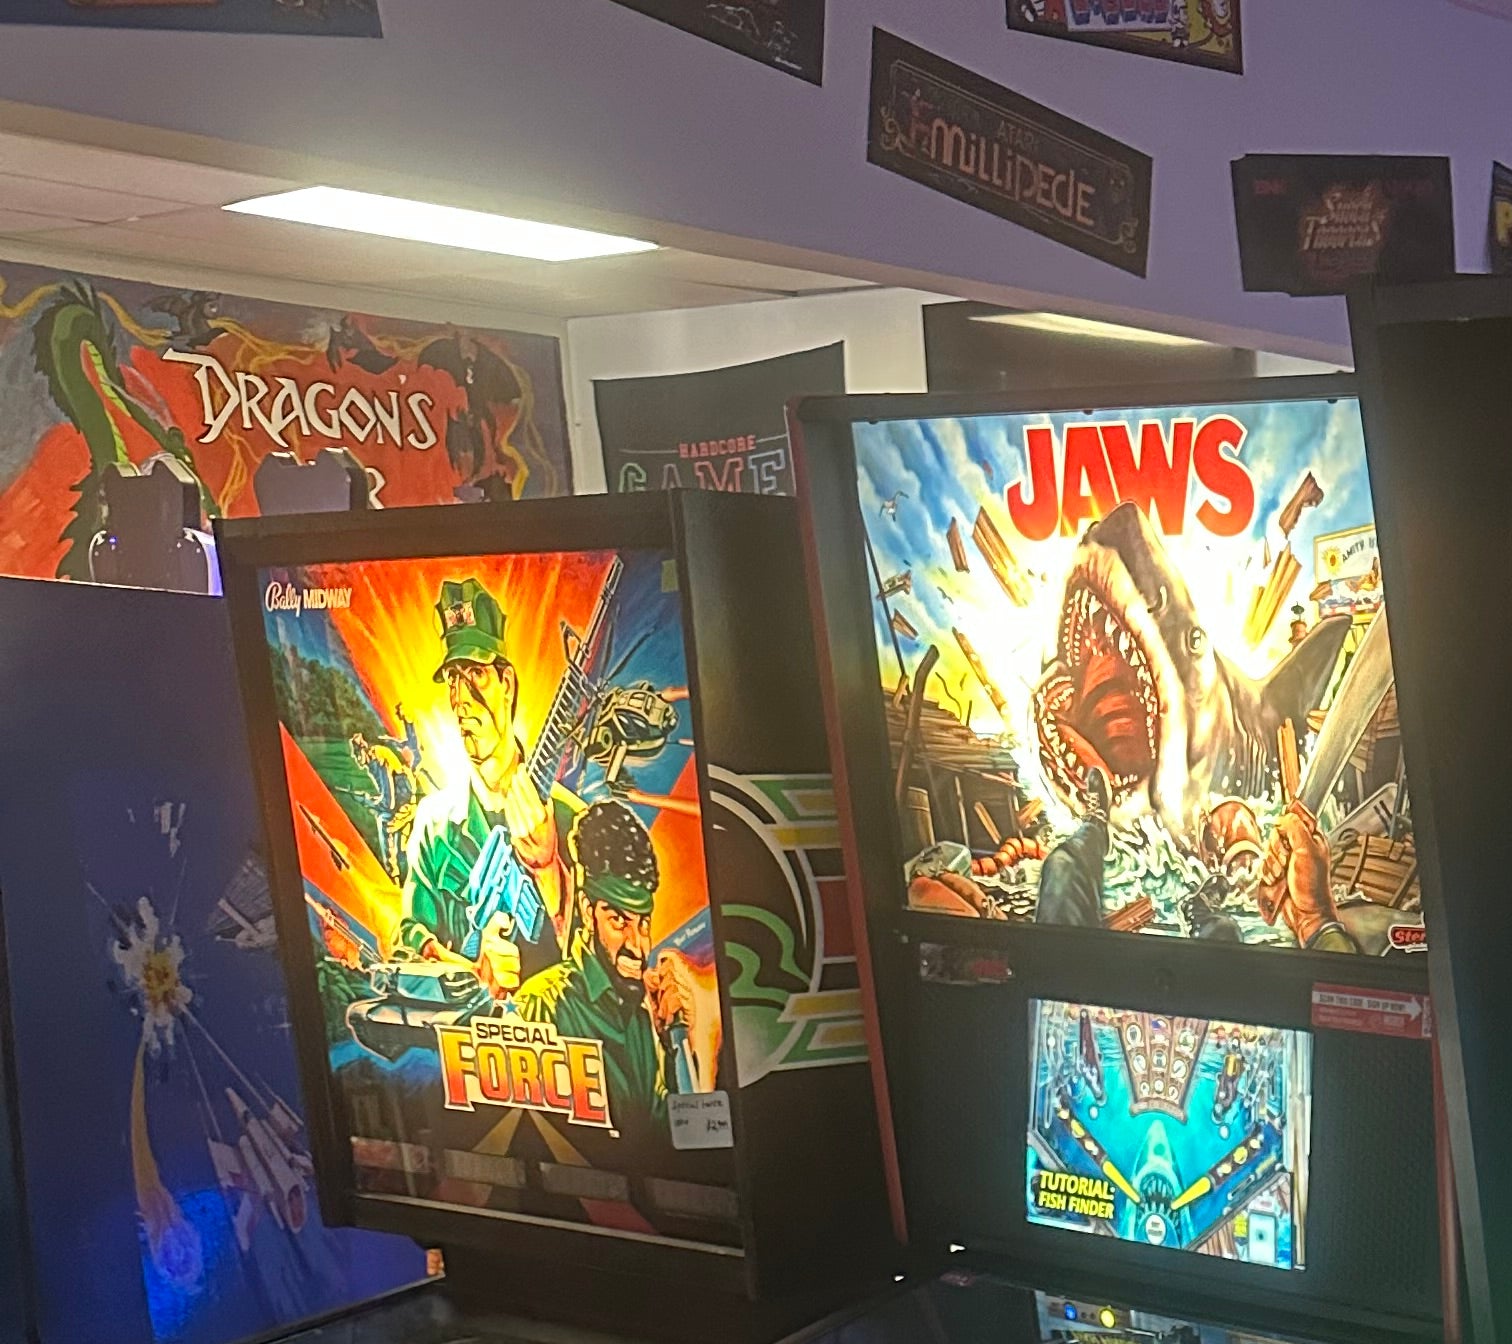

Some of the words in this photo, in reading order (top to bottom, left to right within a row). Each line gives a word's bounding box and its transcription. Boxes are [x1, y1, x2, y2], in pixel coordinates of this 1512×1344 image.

[162, 348, 438, 450] DRAGON'S
[678, 434, 757, 459] HARDCORE
[1007, 413, 1257, 541] JAWS
[265, 581, 302, 617] Bally
[302, 588, 353, 610] MIDWAY
[475, 1022, 559, 1048] SPECIAL
[443, 1029, 612, 1126] FORCE
[1038, 1169, 1116, 1201] TUTORIAL:
[1038, 1189, 1066, 1211] FISH
[1067, 1193, 1116, 1220] FINDER
